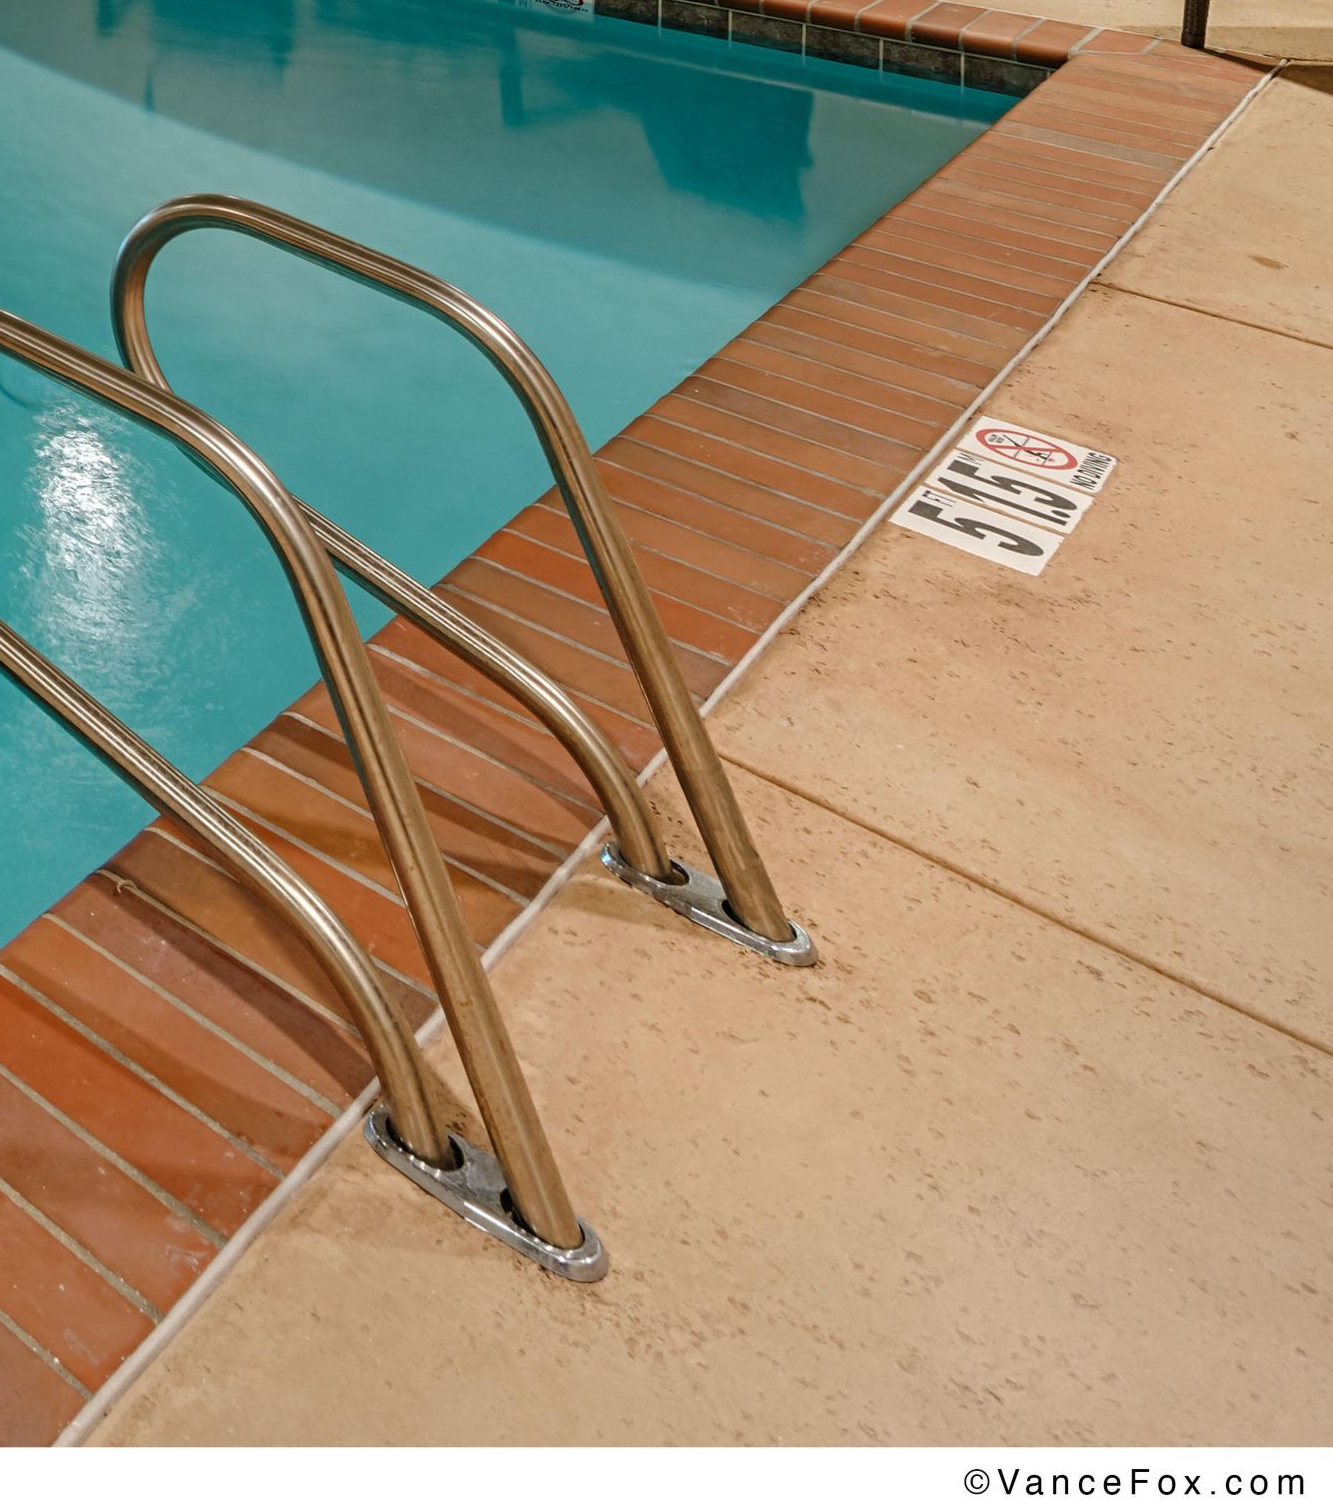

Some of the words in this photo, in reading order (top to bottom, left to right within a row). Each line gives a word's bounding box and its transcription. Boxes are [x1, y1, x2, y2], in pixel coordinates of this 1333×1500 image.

[1069, 475, 1098, 490] NO
[1080, 452, 1113, 483] DIVING
[937, 459, 1078, 526] 1.5
[908, 499, 1045, 557] 5
